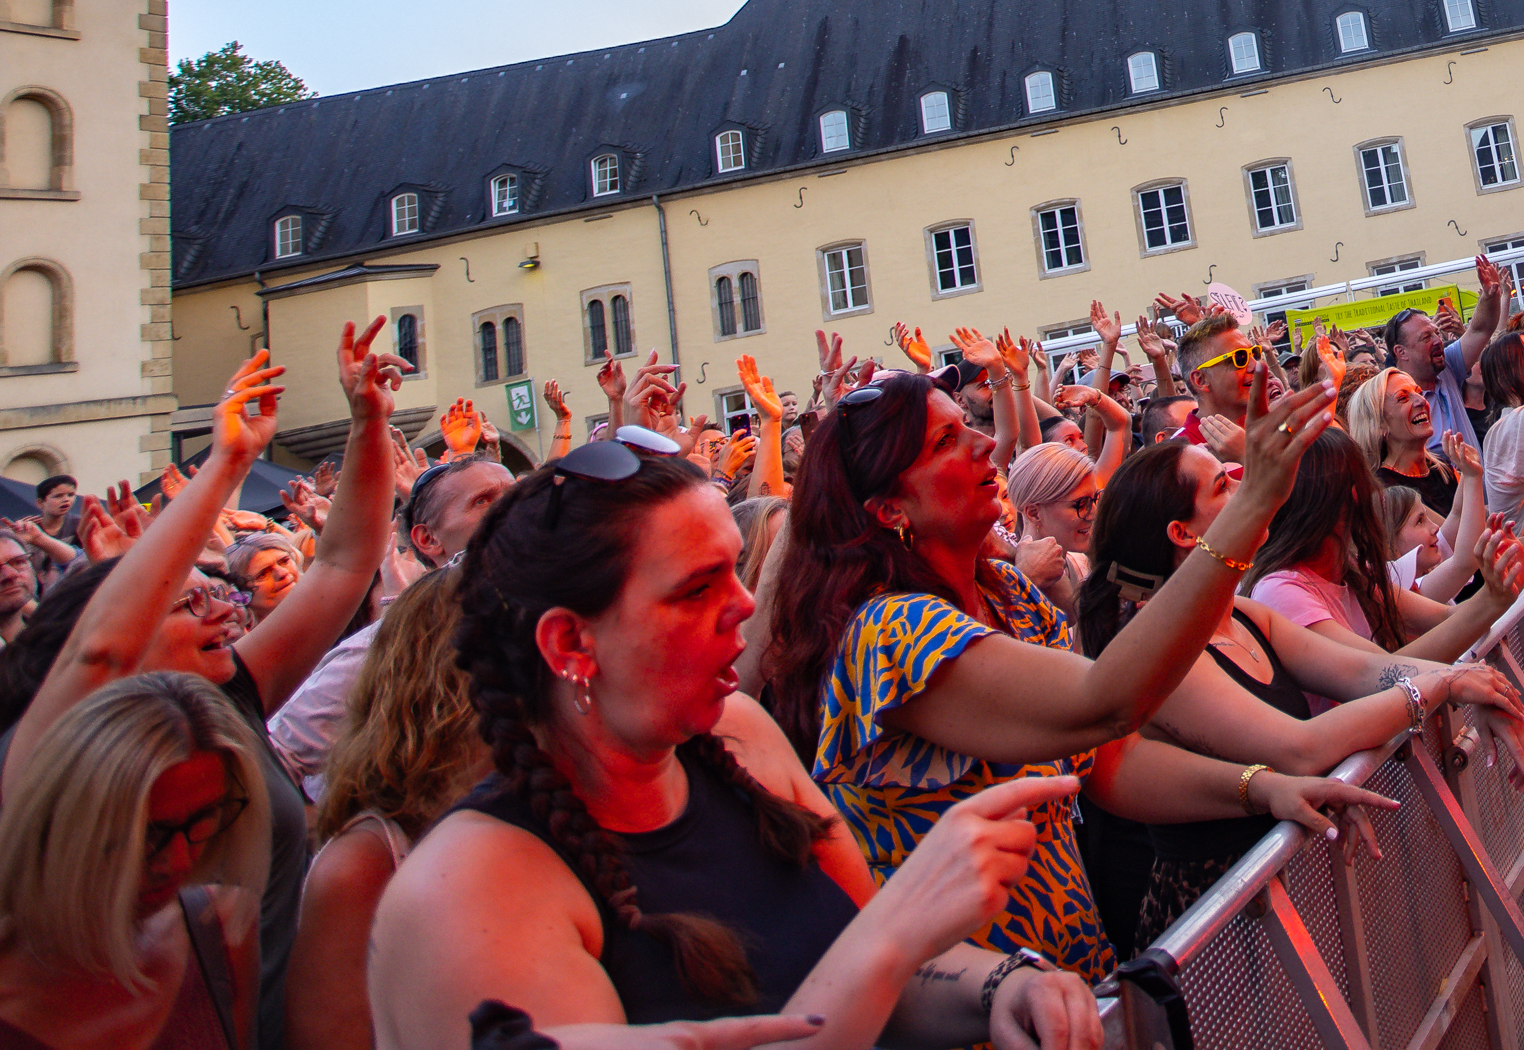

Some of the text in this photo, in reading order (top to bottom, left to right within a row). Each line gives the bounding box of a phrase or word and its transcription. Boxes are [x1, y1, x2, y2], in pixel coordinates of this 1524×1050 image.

[1335, 312, 1343, 320] TRY
[1386, 302, 1400, 311] TASTE
[1407, 296, 1432, 307] THAILAND
